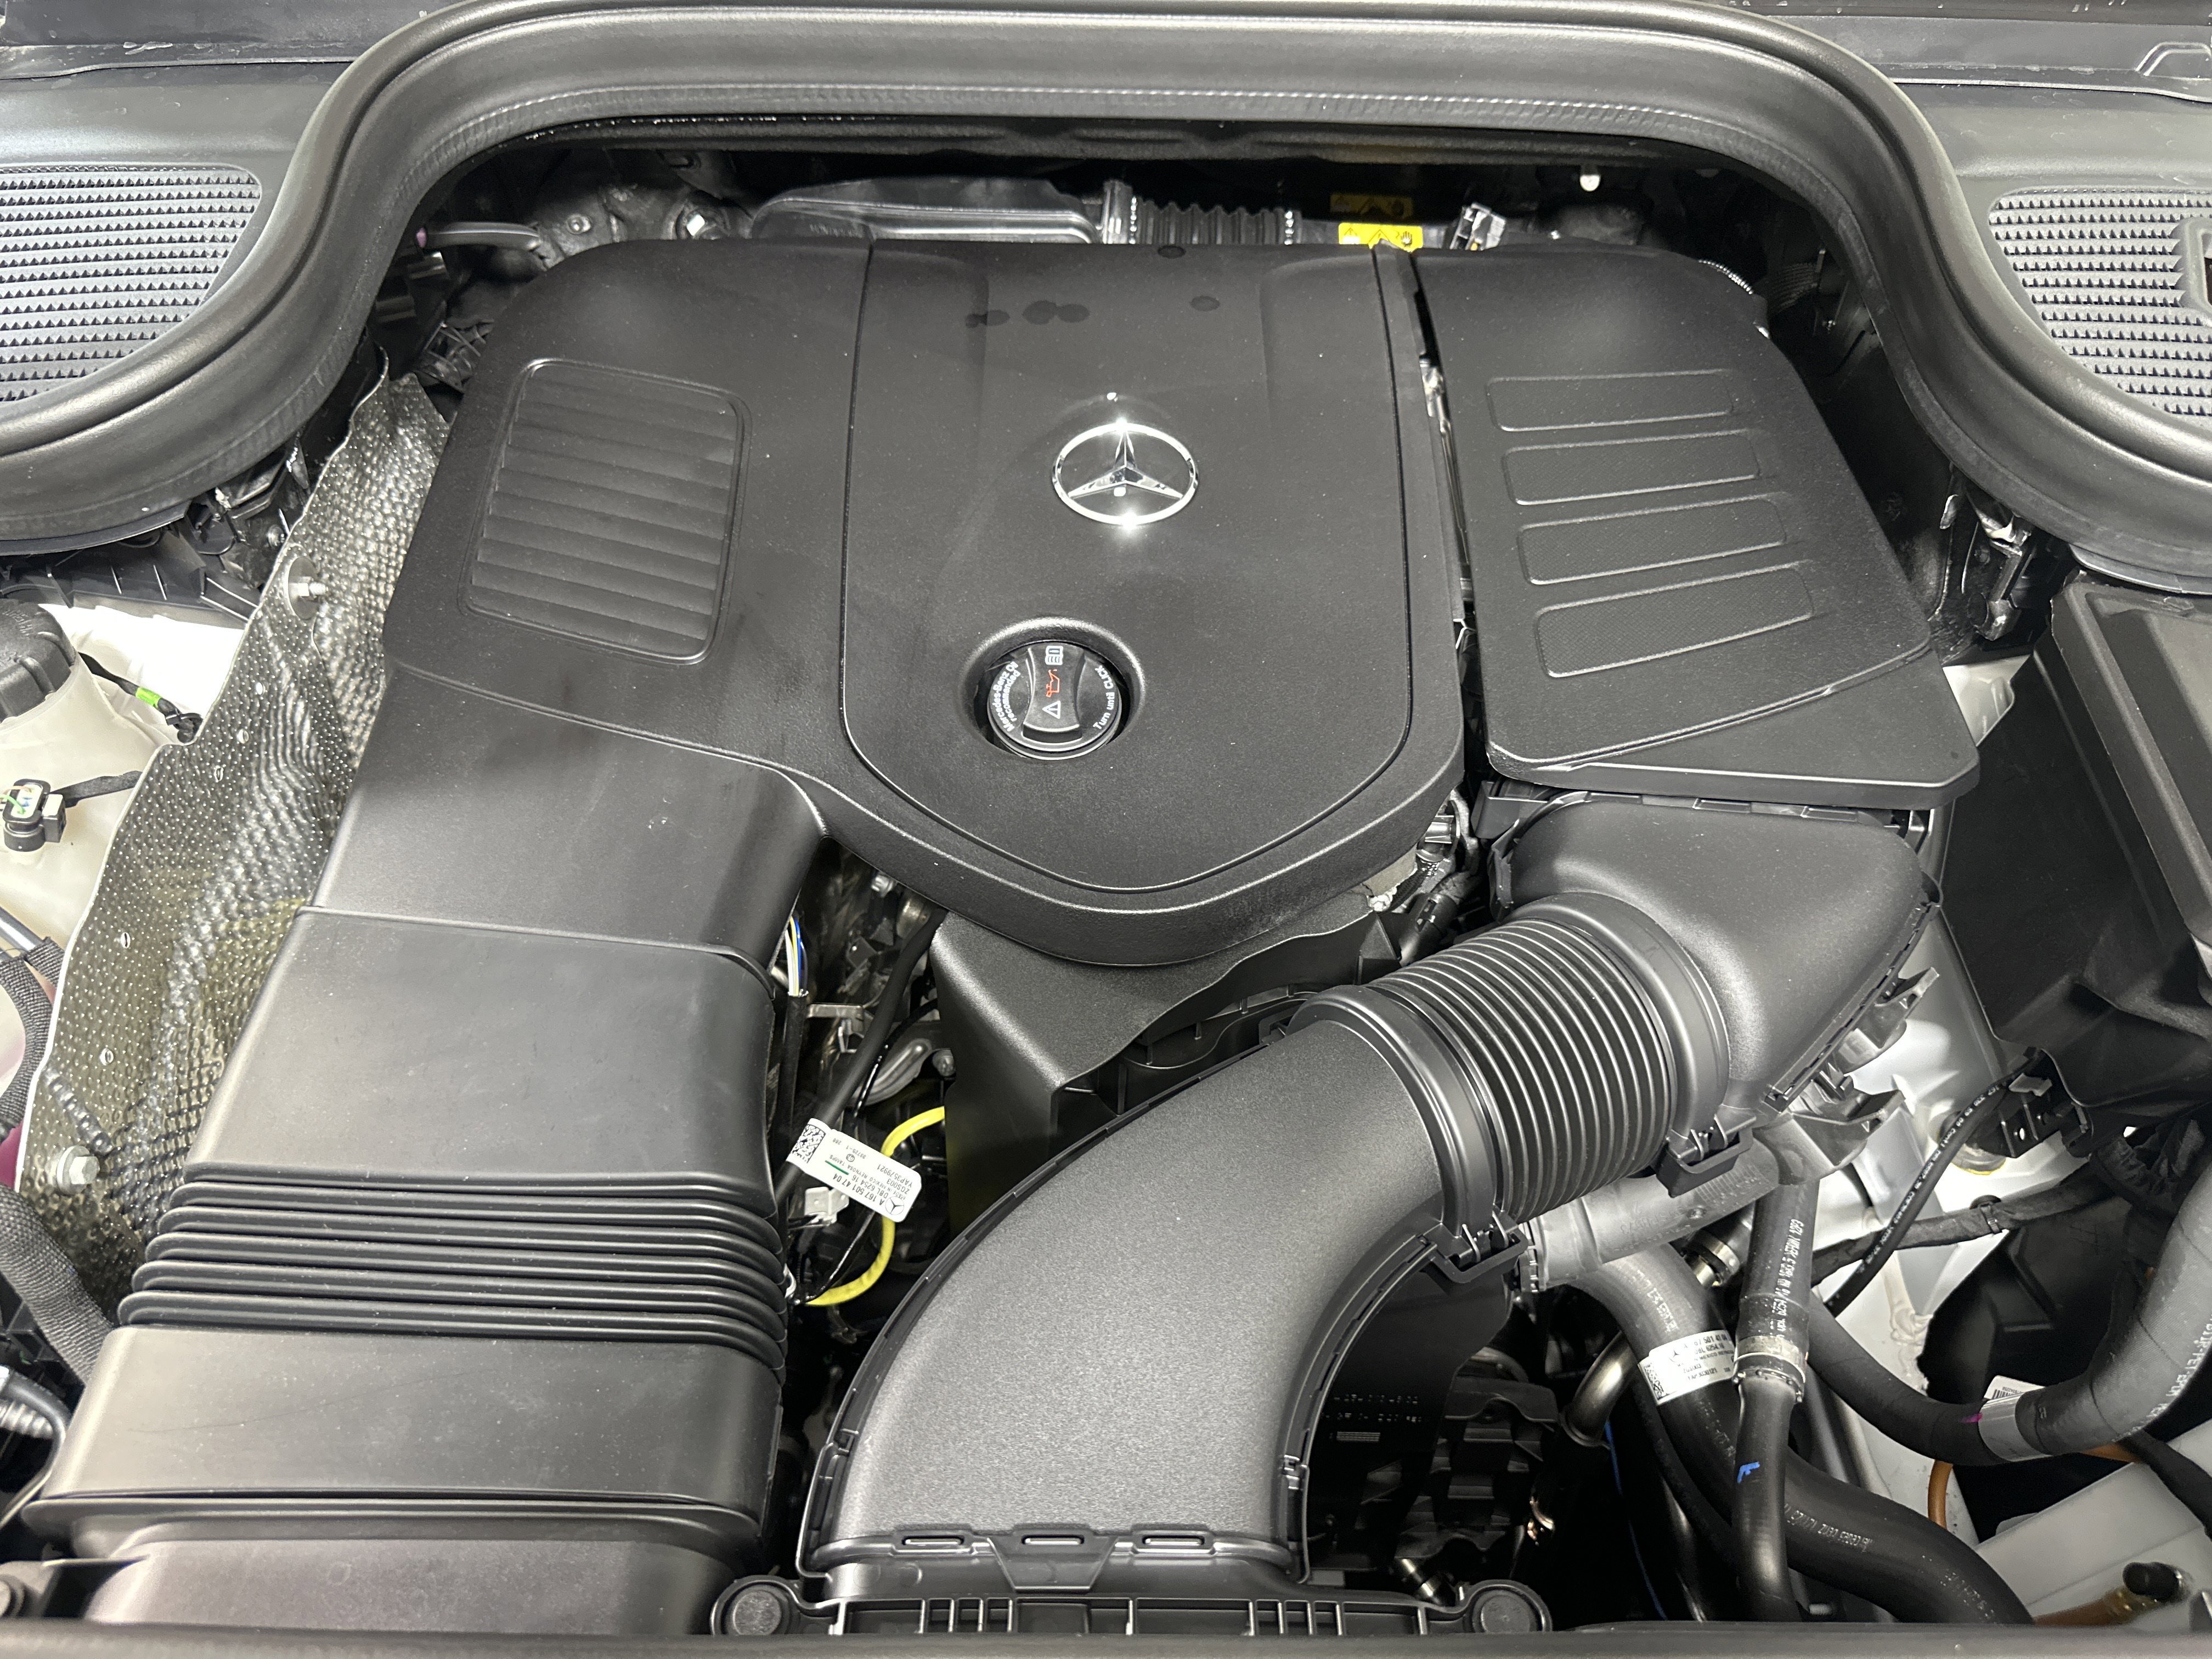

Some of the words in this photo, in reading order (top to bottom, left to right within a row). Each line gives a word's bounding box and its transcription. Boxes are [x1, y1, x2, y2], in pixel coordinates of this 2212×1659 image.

[1095, 665, 1114, 689] CLICK
[992, 671, 1015, 732] Mercedes-Benz
[1006, 662, 1019, 673] Oil
[1002, 670, 1020, 722] recommended
[1105, 692, 1115, 710] until
[1093, 713, 1111, 730] Turn
[847, 1164, 867, 1178] REYNOSA
[876, 1164, 913, 1187] YAP3579921
[833, 1173, 842, 1182] 04
[842, 1178, 851, 1187] 47
[869, 1177, 886, 1188] MEXICO
[851, 1184, 864, 1194] 501
[860, 1180, 875, 1190] 6254
[887, 1178, 910, 1193] ZGS003
[865, 1191, 877, 1201] 167
[876, 1188, 888, 1198] DBL
[1703, 1335, 1714, 1344] 501
